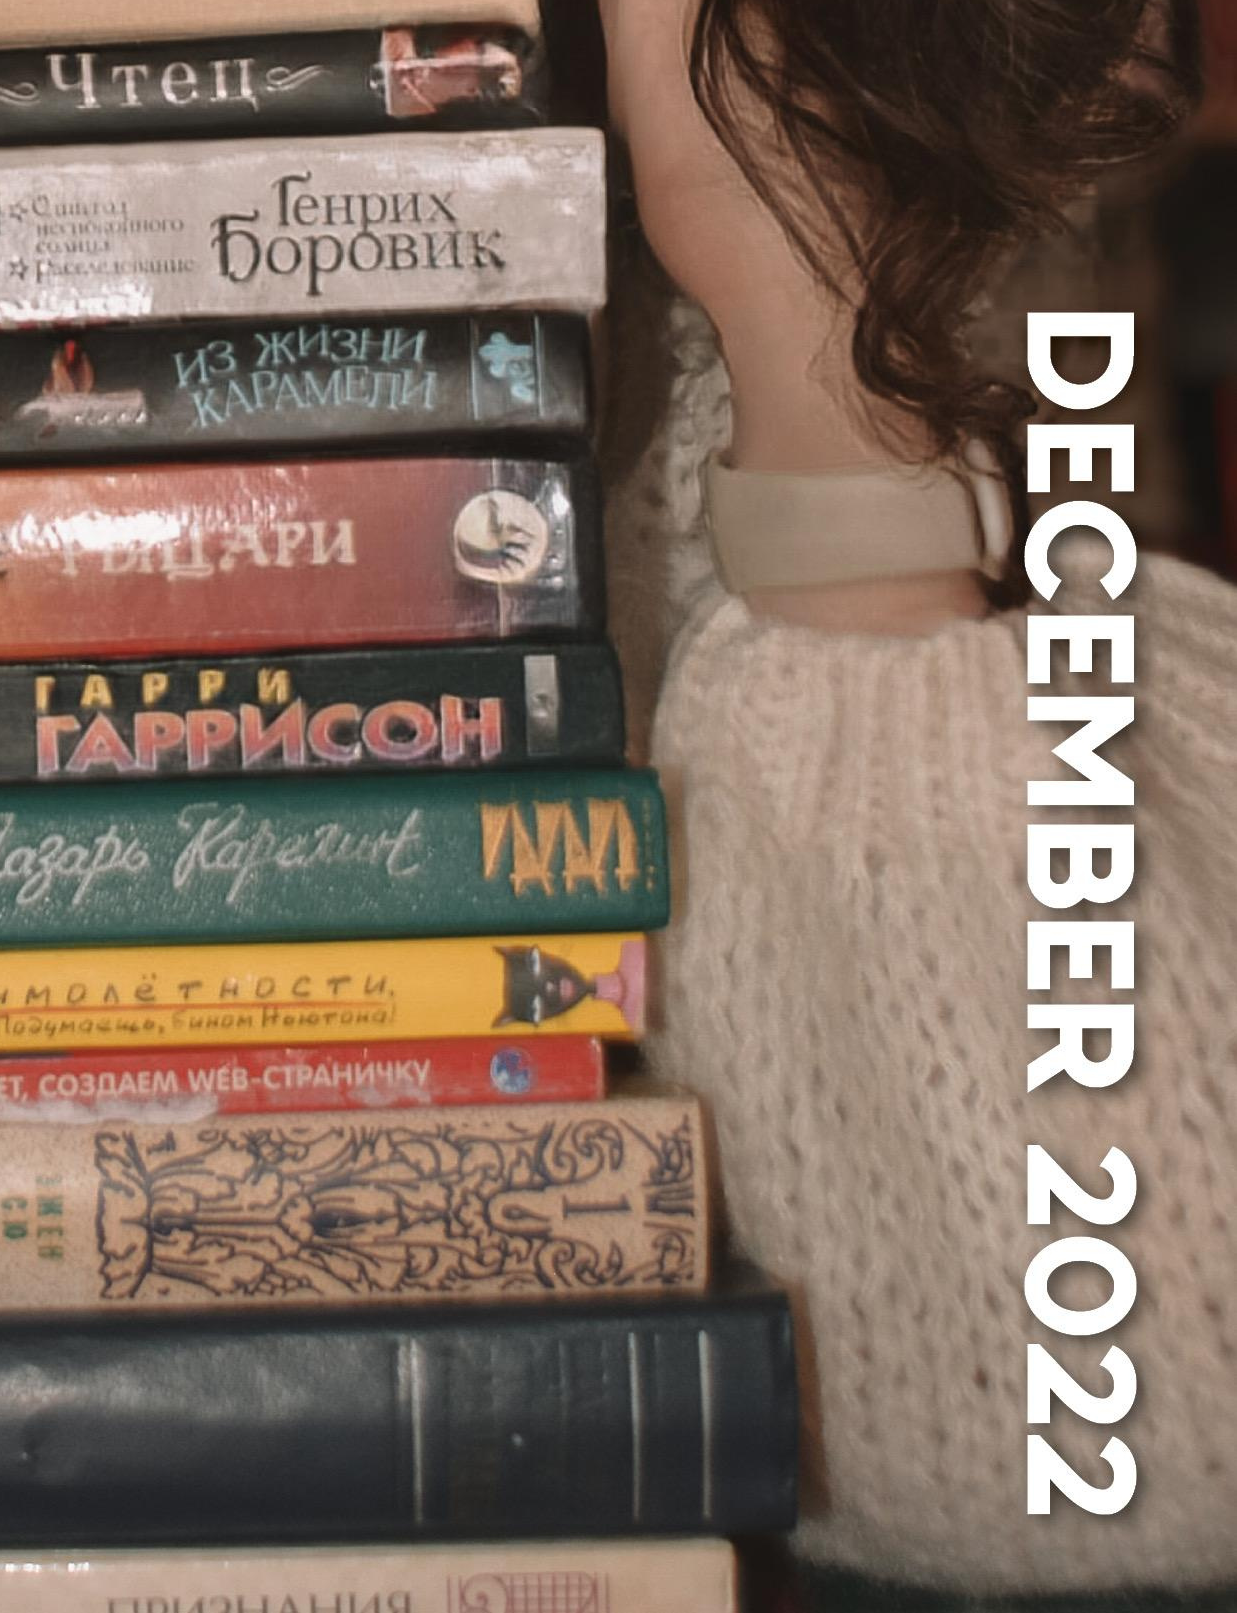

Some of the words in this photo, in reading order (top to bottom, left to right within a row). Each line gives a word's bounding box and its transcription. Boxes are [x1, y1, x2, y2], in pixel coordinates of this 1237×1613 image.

[45, 52, 261, 113] Чтец
[271, 171, 458, 231] Генрих
[211, 208, 507, 296] Боровик
[173, 340, 237, 389] ИЗ
[254, 323, 428, 369] ЖИЗНИ
[190, 364, 438, 429] КАРАМЕЛИ
[35, 667, 291, 711] ГАРРИ
[35, 694, 504, 776] ГАРРИСОН
[38, 1070, 177, 1101] СОЗДАЕМ
[188, 1058, 432, 1094] WEB-СТРАНИЧКУ
